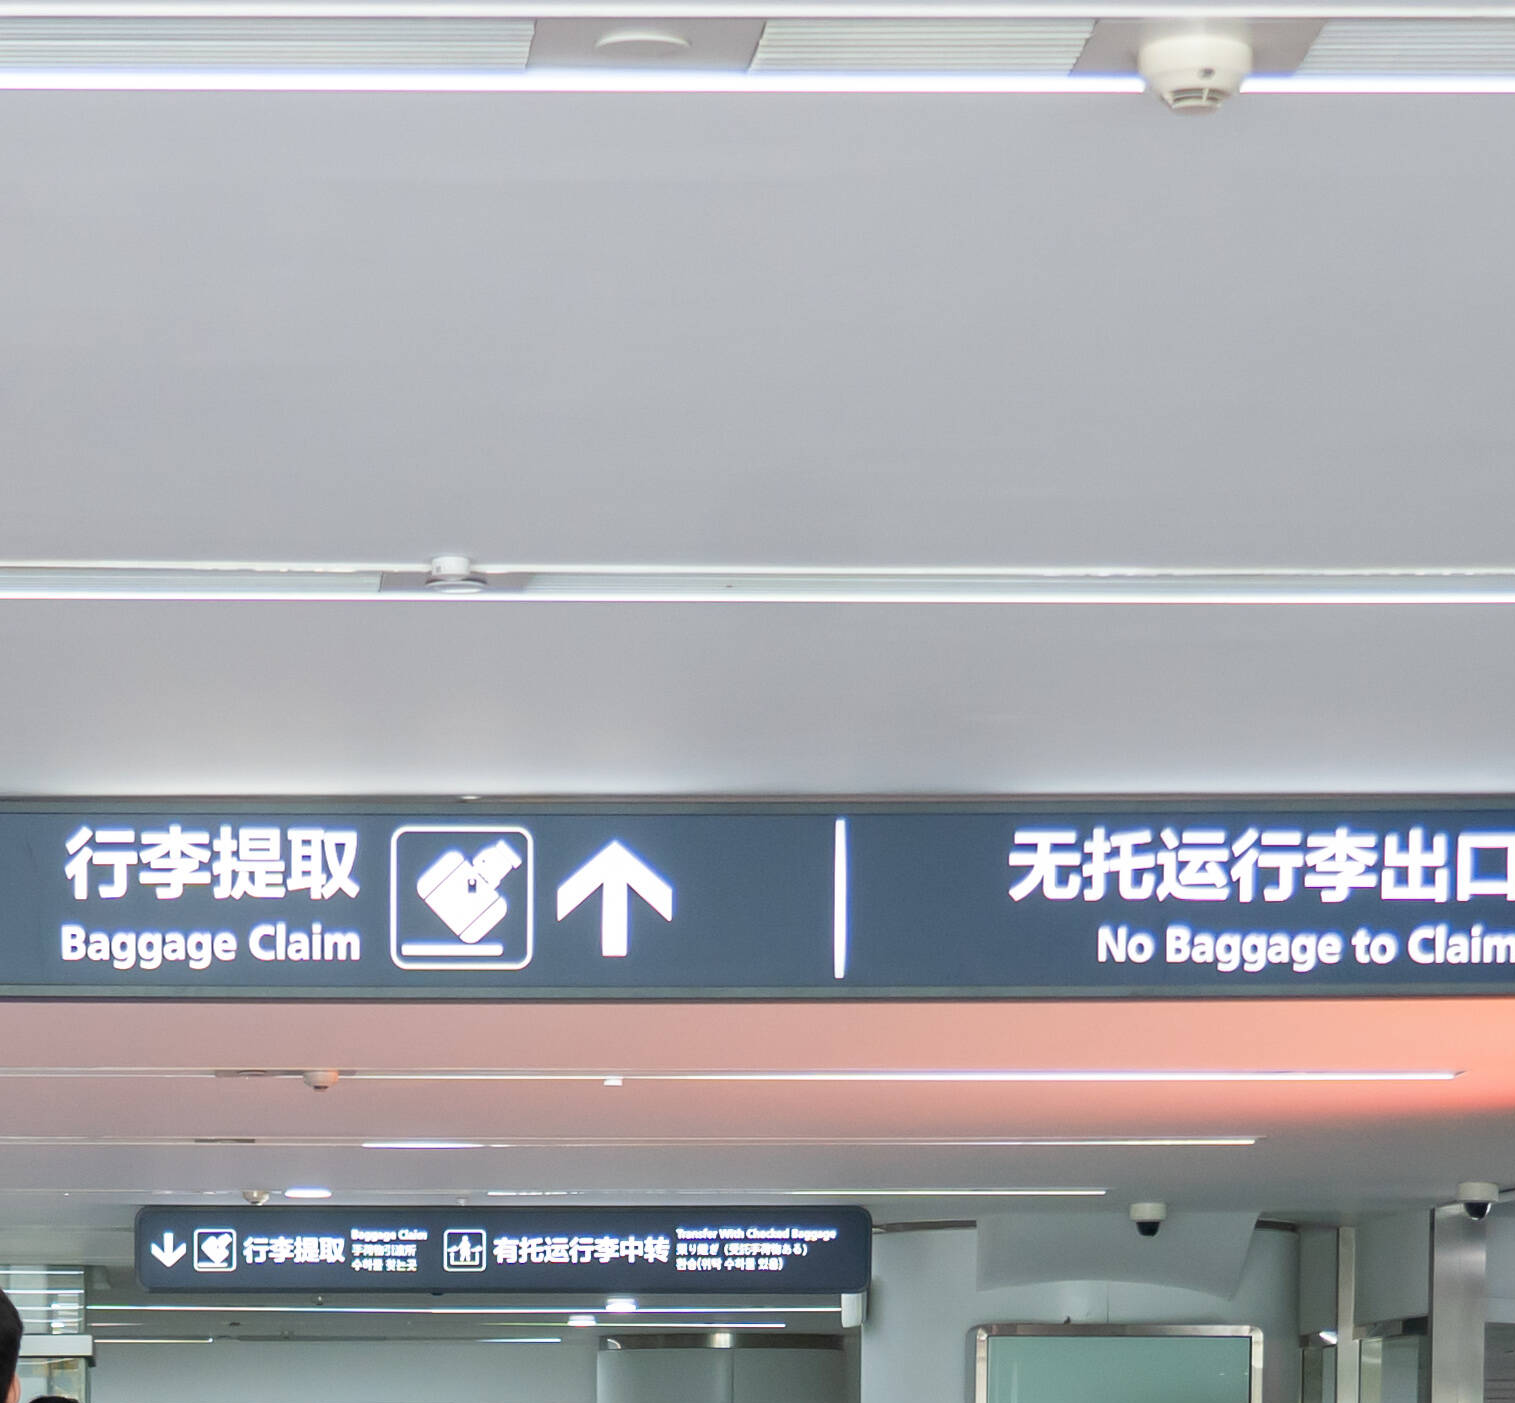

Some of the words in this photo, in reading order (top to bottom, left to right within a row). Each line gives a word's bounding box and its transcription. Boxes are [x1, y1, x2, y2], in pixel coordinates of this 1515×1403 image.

[61, 826, 361, 905] 行李提取
[60, 923, 236, 972] Baggage
[248, 923, 362, 963] Claim
[1096, 925, 1155, 965] No
[1165, 925, 1342, 973] Baggage
[1350, 927, 1398, 966] to
[351, 1229, 396, 1242] Baggage
[398, 1229, 428, 1241] Claim
[676, 1228, 718, 1240] Transfer
[719, 1228, 744, 1240] With
[746, 1228, 789, 1240] Checked
[791, 1228, 837, 1242] Baggage
[243, 1236, 346, 1264] 行李提取
[493, 1236, 670, 1264] 有托运行李中转
